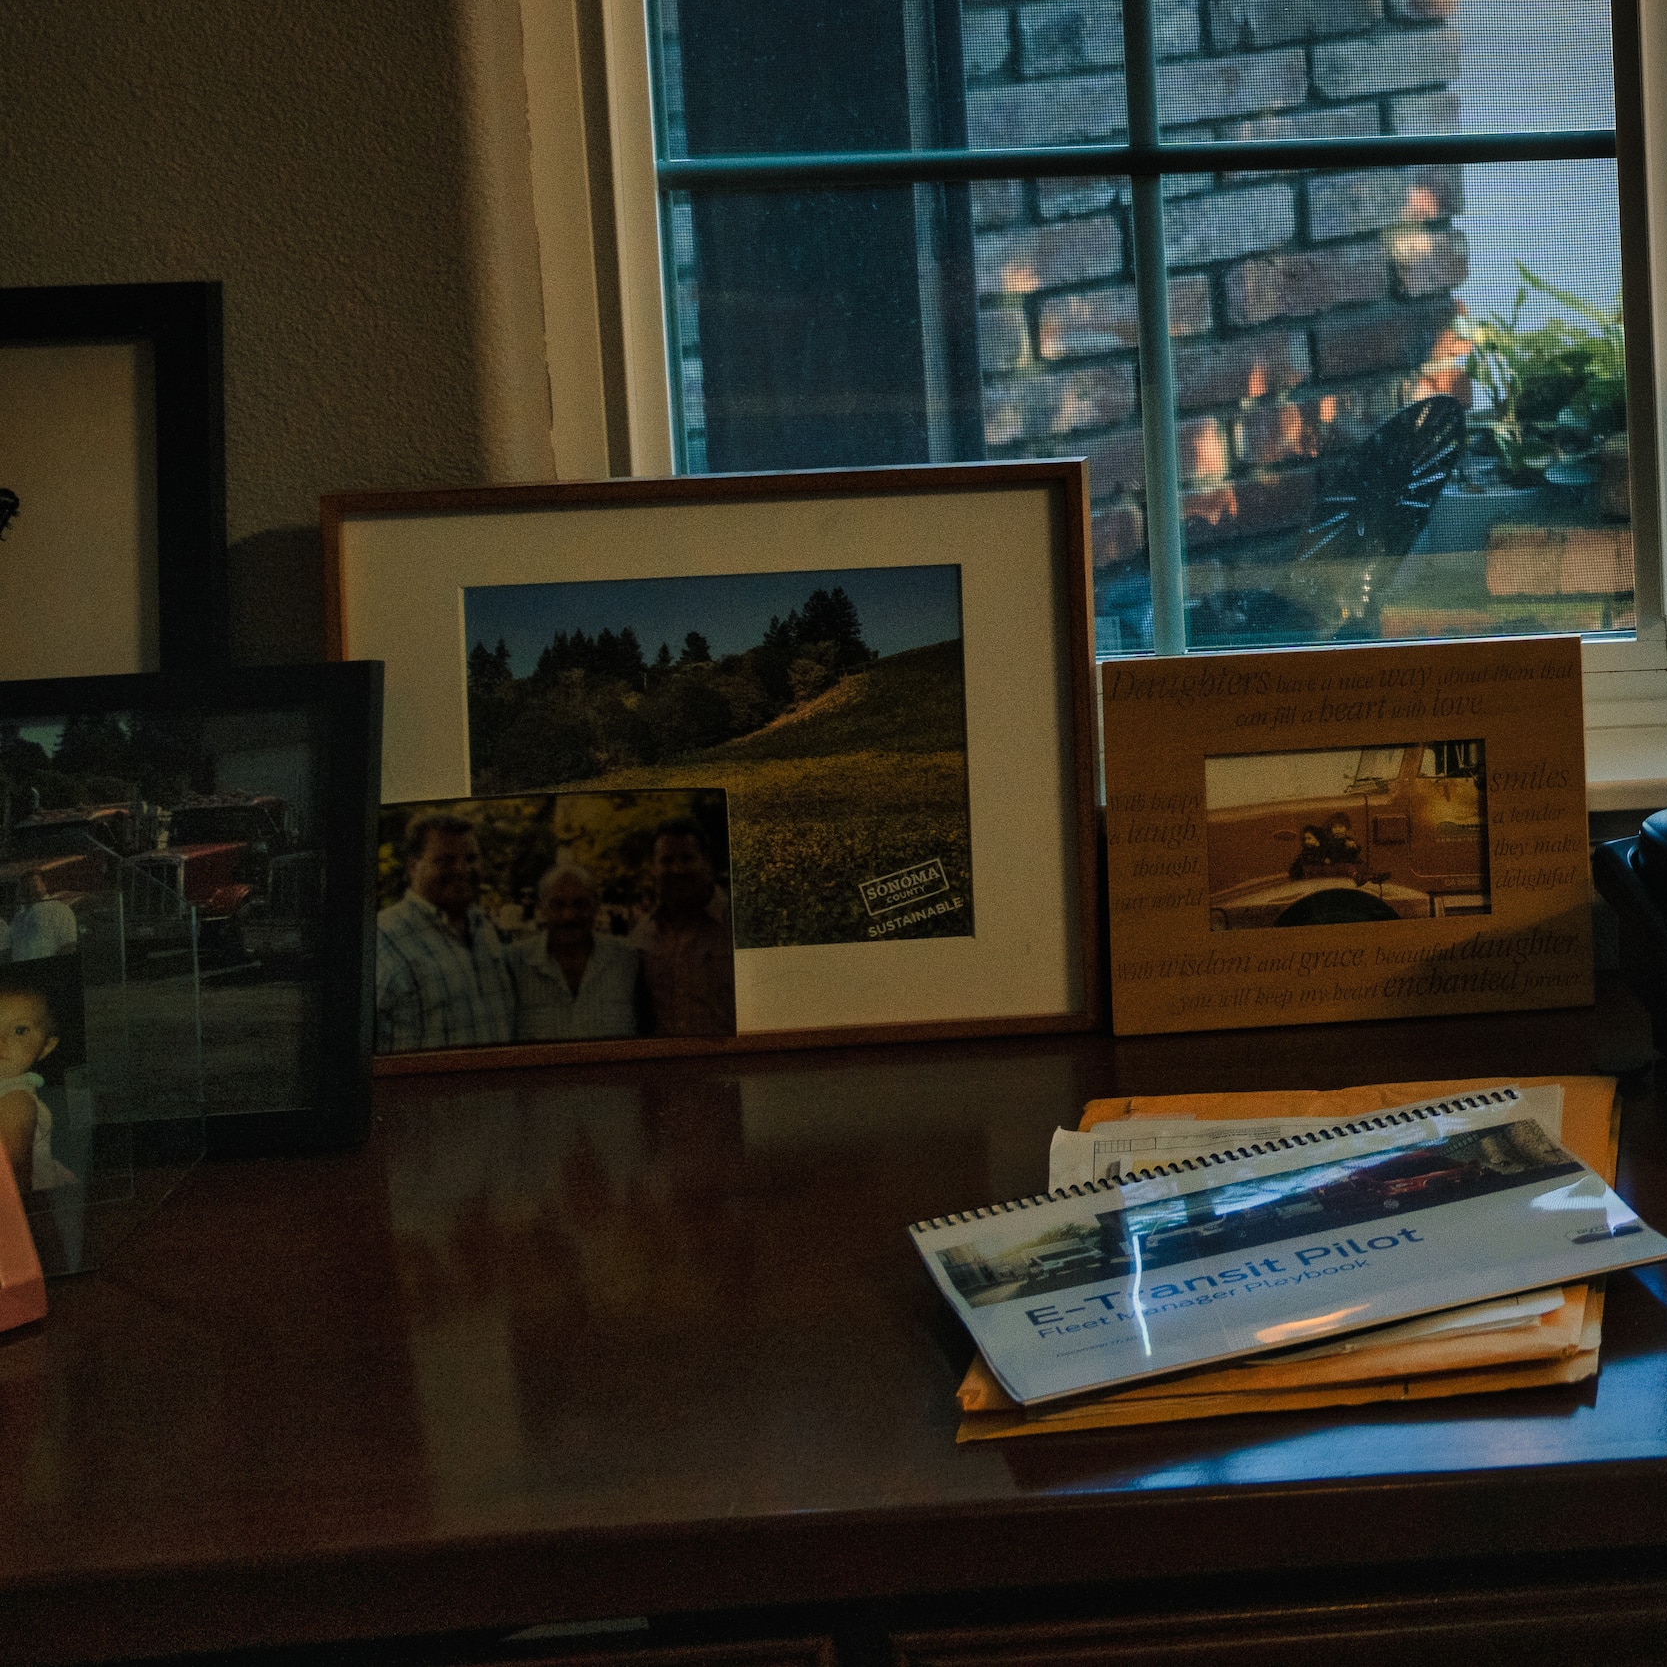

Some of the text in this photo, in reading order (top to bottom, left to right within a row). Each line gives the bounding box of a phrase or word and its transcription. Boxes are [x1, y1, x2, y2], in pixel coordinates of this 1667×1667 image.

[866, 866, 940, 900] SONOMA
[886, 885, 926, 904] COUNTY
[867, 896, 964, 937] SUSTAINABLE
[1293, 1226, 1424, 1268] Pilot
[1037, 1314, 1112, 1340] Fleet
[1243, 1259, 1370, 1292] Playbook
